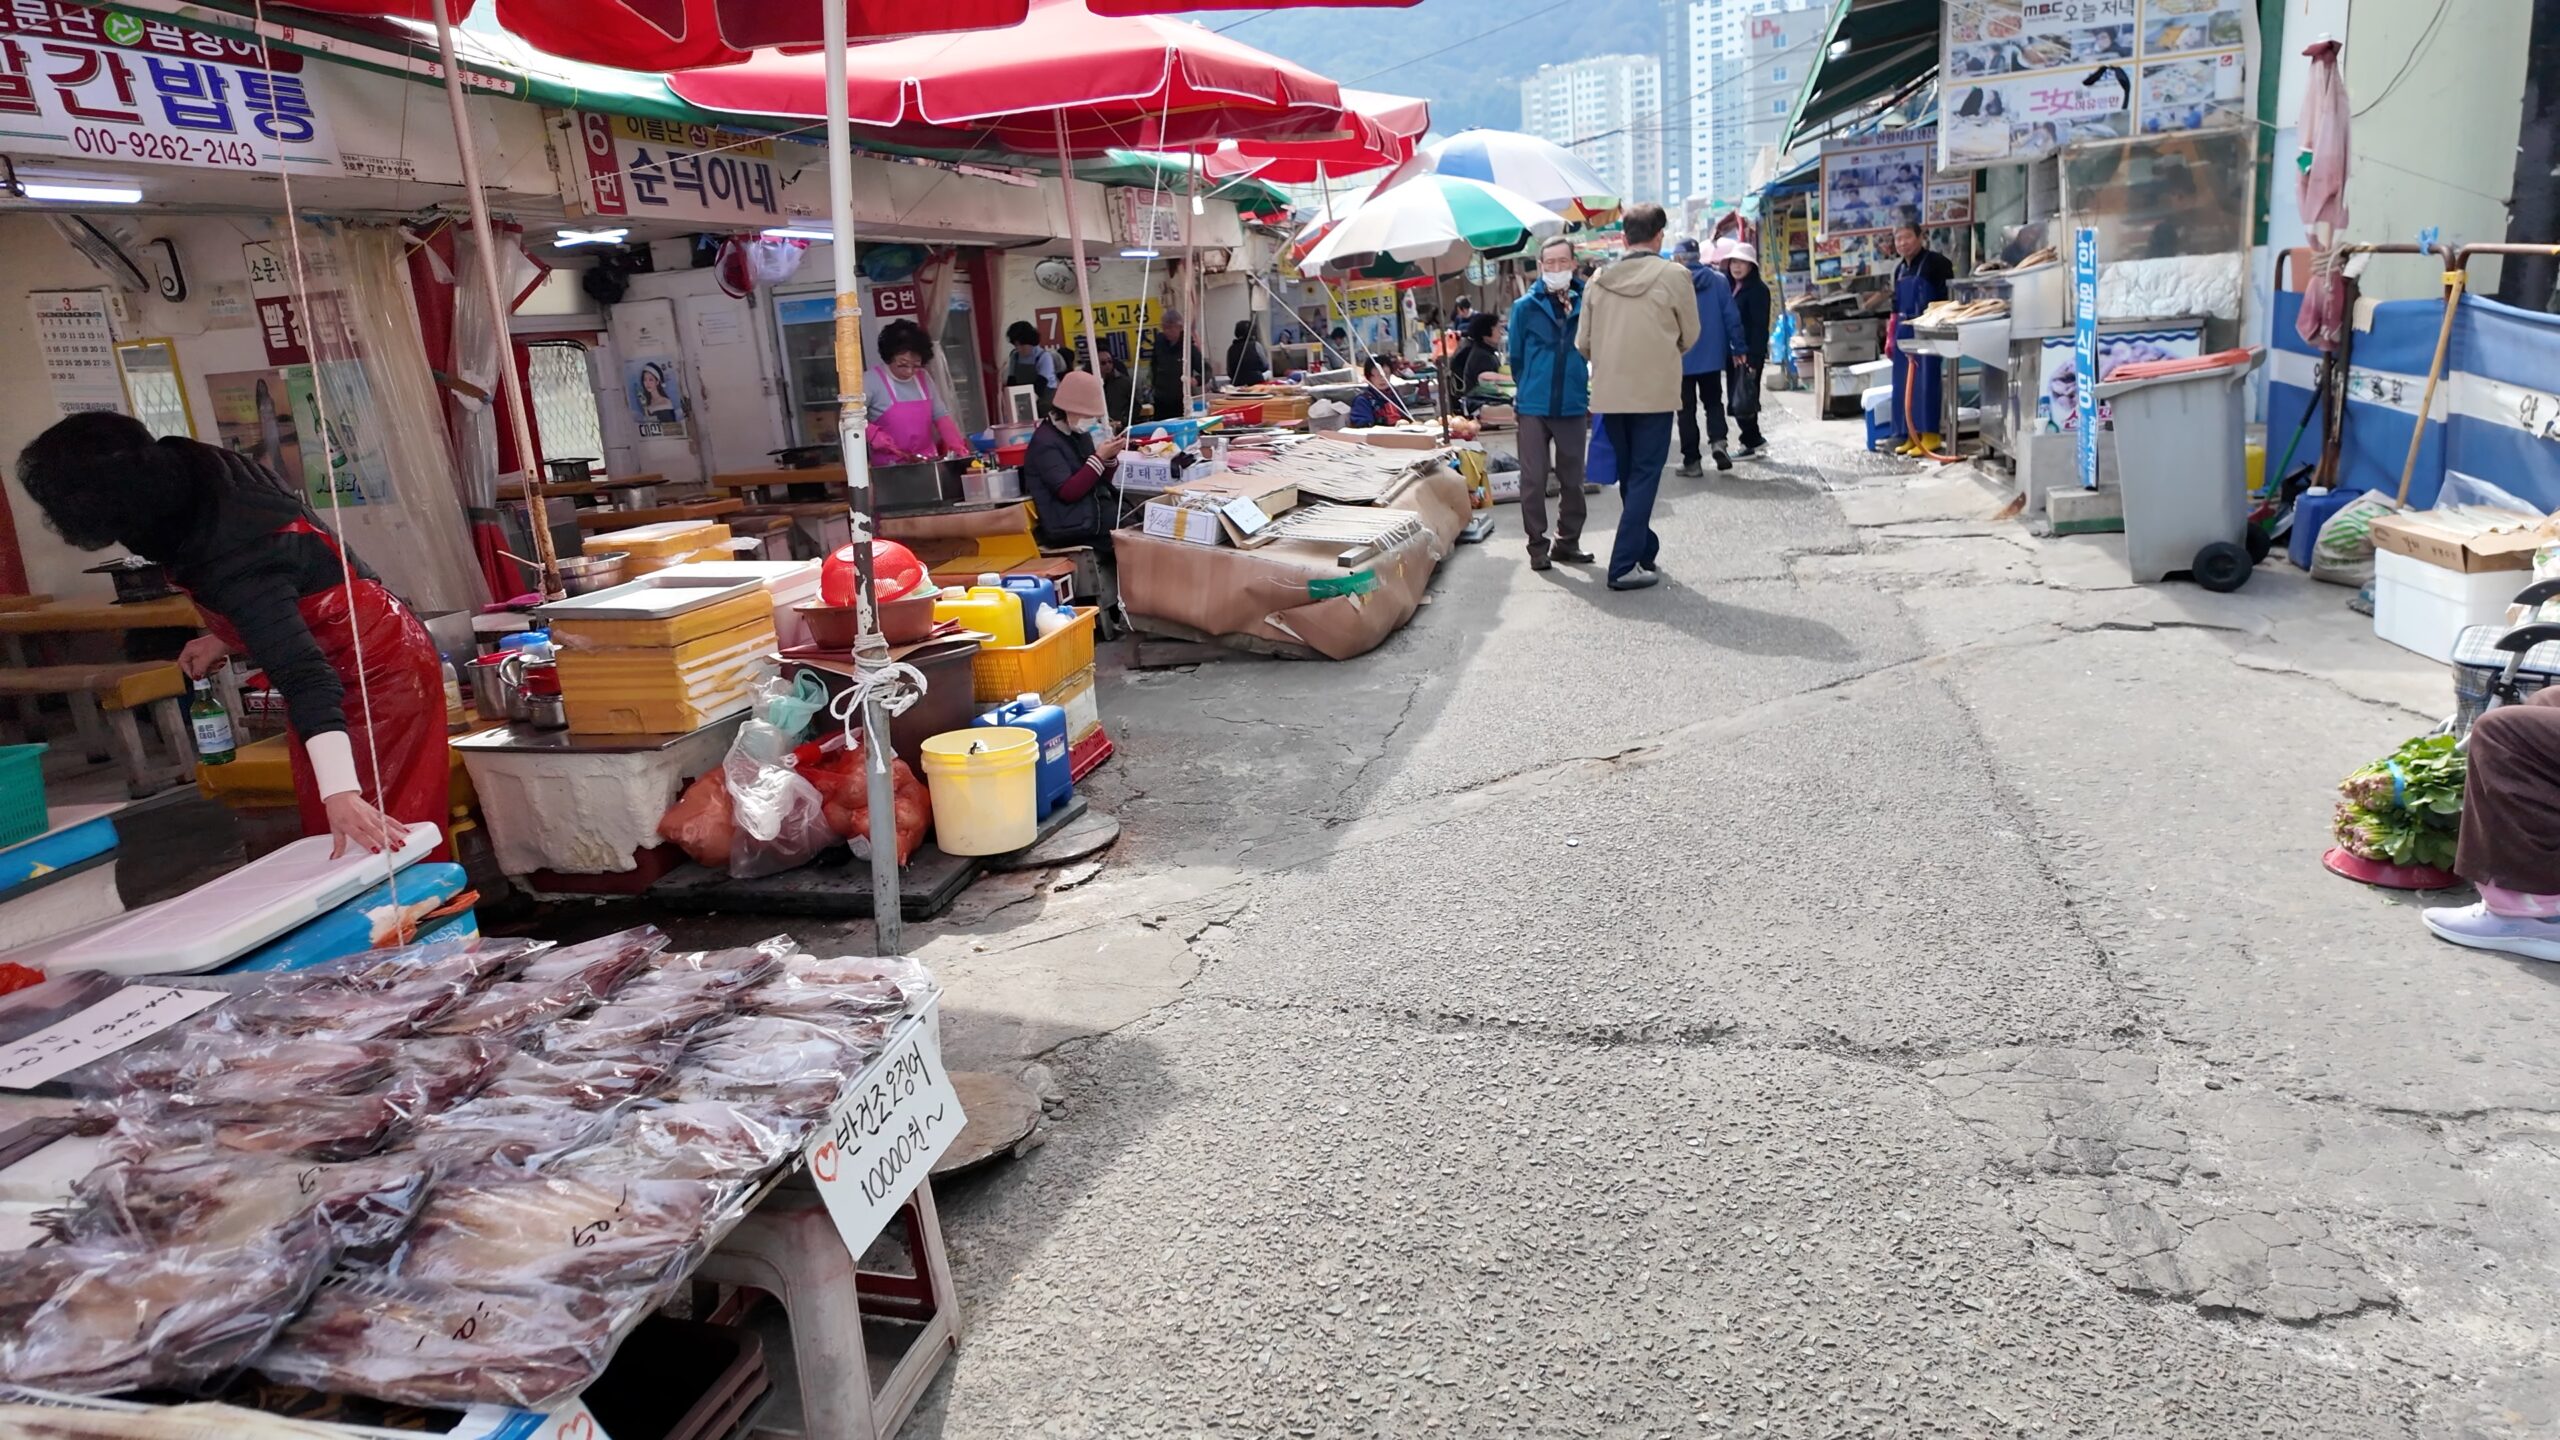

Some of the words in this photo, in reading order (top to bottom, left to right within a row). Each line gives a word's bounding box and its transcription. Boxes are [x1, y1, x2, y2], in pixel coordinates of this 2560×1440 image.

[73, 125, 257, 166] 010-9262-2143
[628, 147, 778, 214] 순덕이네
[880, 290, 917, 311] 6번
